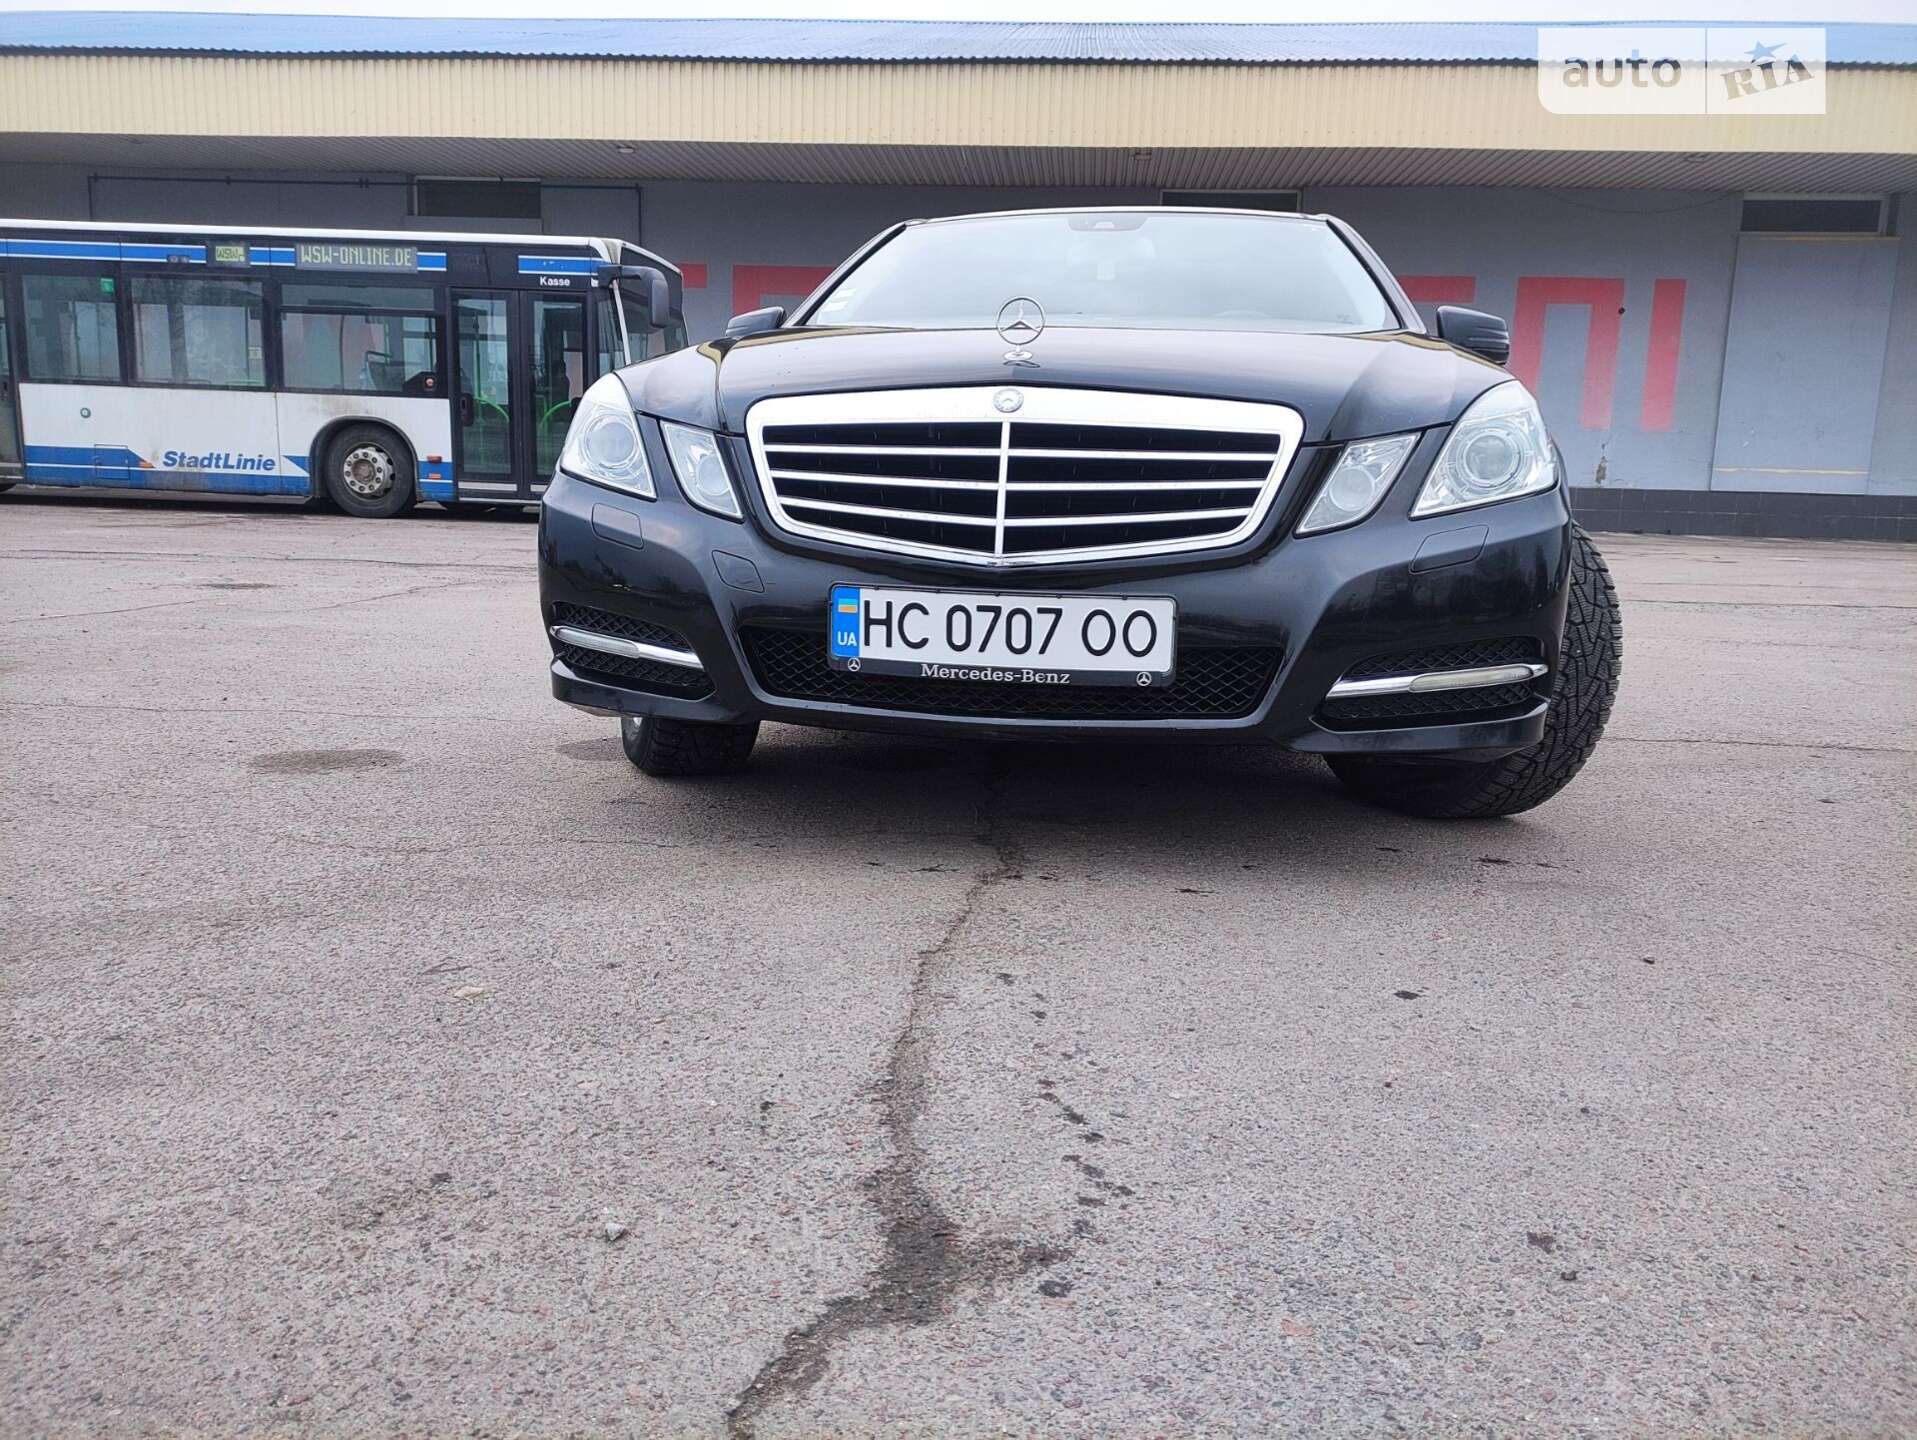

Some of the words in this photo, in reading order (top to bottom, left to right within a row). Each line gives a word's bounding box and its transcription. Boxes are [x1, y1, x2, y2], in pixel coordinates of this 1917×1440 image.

[301, 246, 412, 267] WSW-ONLINE.DE
[540, 276, 571, 287] Kasse
[163, 450, 276, 471] StadtLinie
[837, 631, 858, 647] UA
[863, 600, 930, 650] HC
[945, 604, 1063, 656] 0707
[1081, 609, 1158, 657] OO
[920, 663, 1071, 685] Mercedes-Benz
